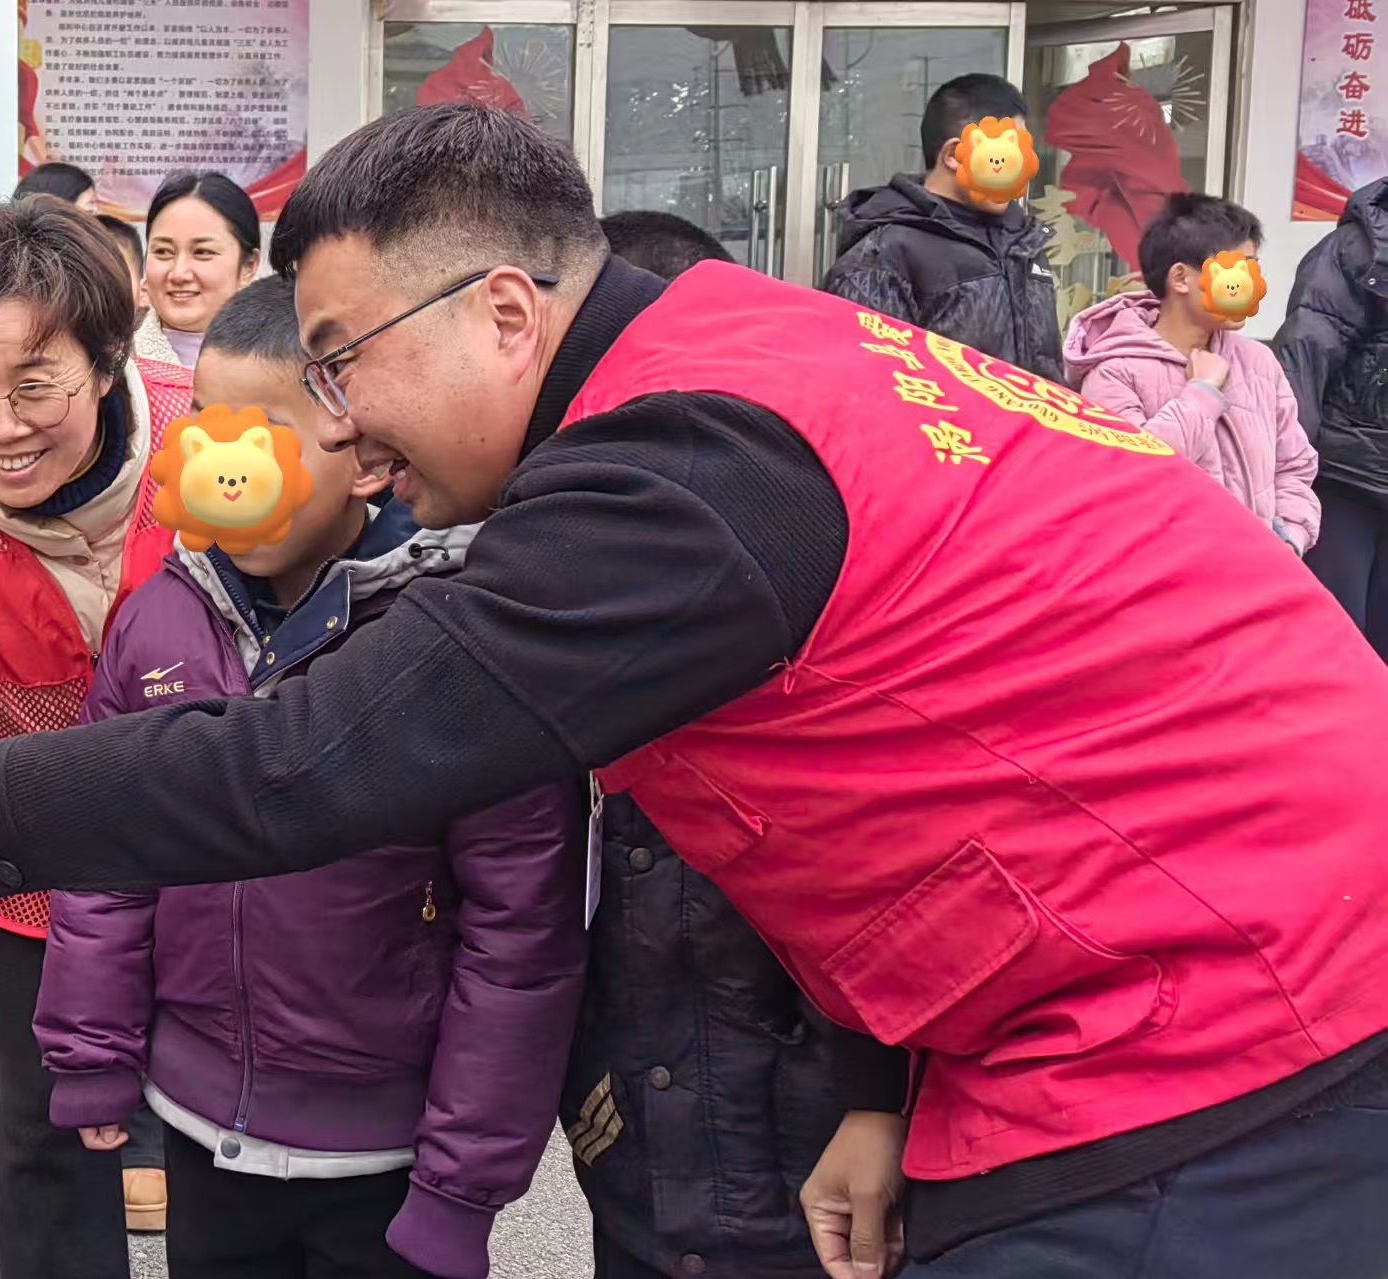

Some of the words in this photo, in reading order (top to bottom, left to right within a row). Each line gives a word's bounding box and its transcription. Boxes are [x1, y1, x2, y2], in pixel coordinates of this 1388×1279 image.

[1337, 0, 1376, 137] 砥砺奋进
[144, 681, 184, 697] ERKE
